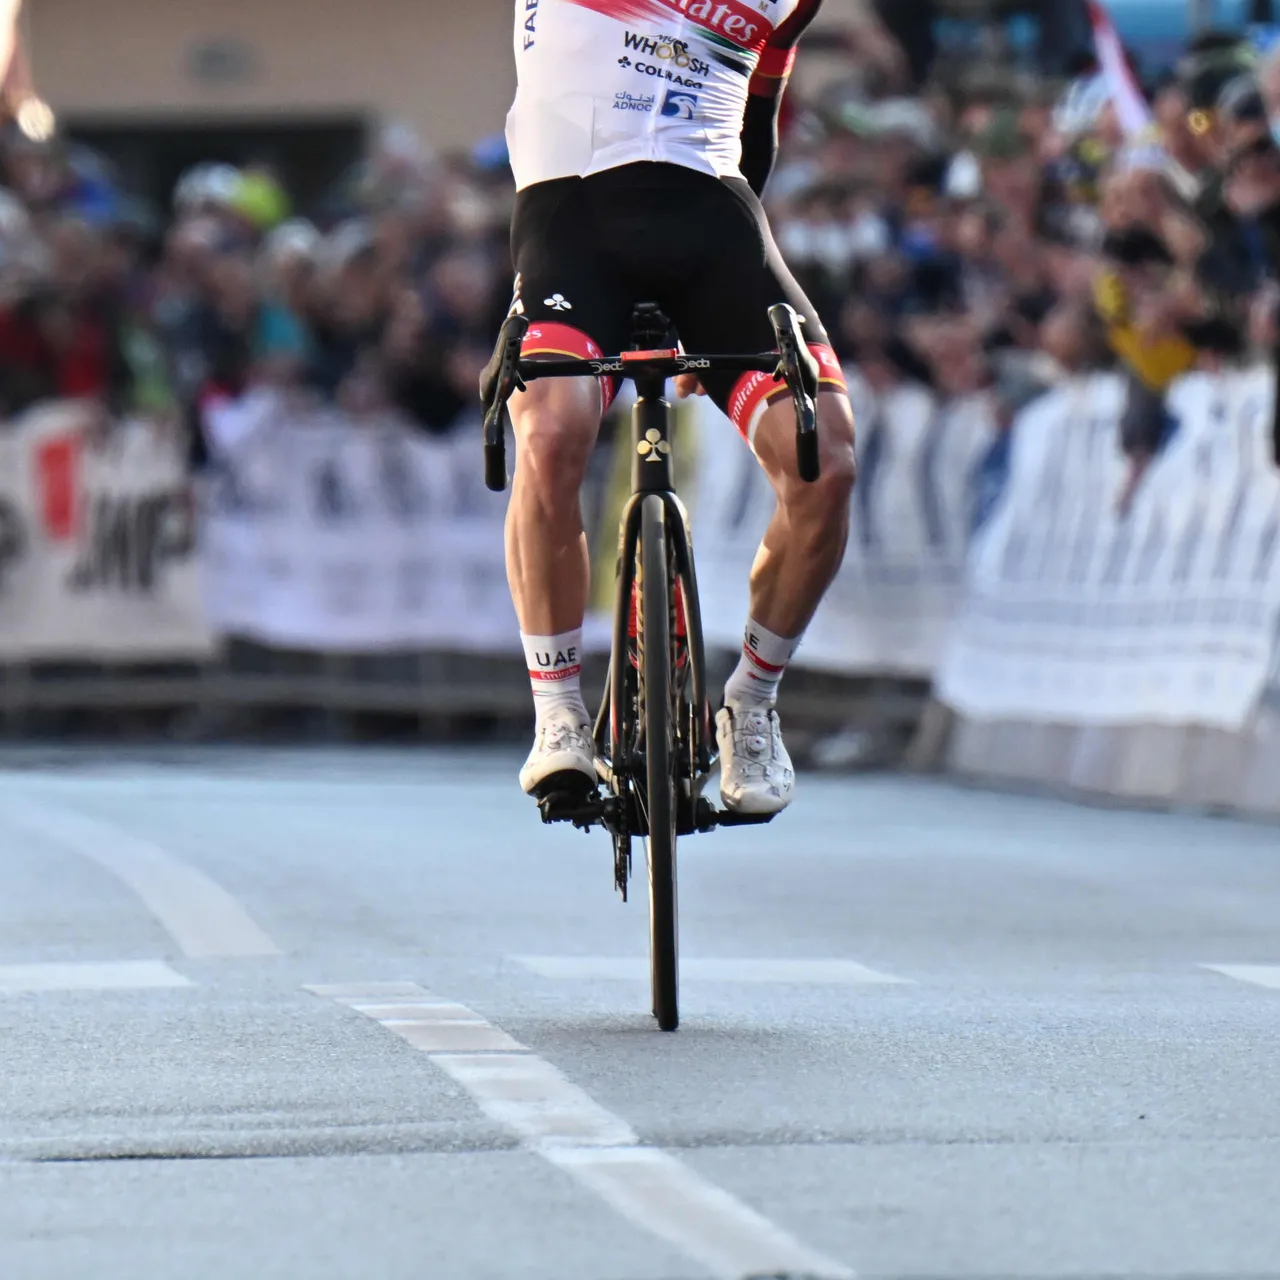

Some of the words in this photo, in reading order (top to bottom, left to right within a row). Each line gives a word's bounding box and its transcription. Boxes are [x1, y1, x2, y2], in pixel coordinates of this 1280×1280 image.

[623, 30, 710, 77] WHOOSH
[634, 61, 703, 90] COLNAGO
[612, 101, 653, 112] ADNOC
[731, 371, 772, 427] mirate
[535, 647, 577, 667] UAE
